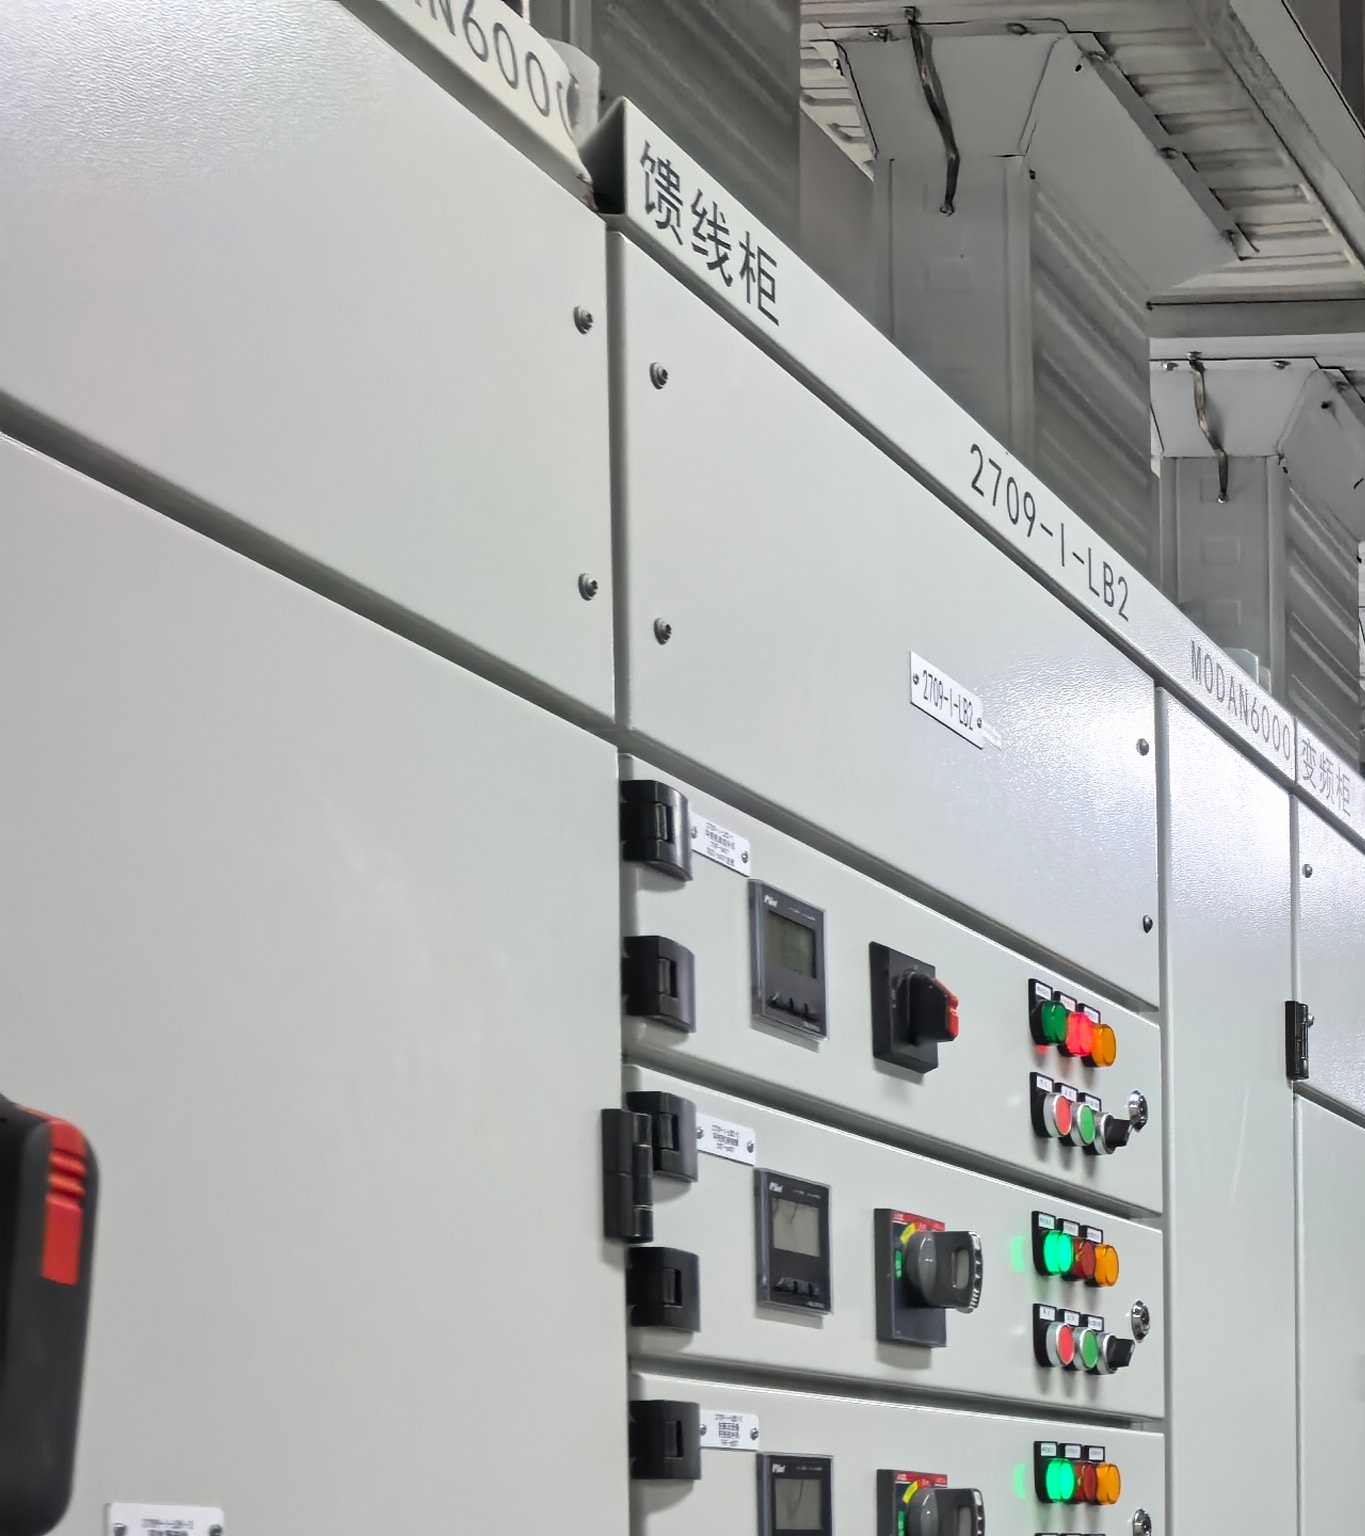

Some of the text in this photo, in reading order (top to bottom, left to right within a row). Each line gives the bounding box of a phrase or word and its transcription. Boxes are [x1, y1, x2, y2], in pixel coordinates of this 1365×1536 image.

[639, 140, 780, 326] 馈线柜
[1190, 639, 1291, 762] MODAN6000
[1301, 738, 1351, 818] 变频柜
